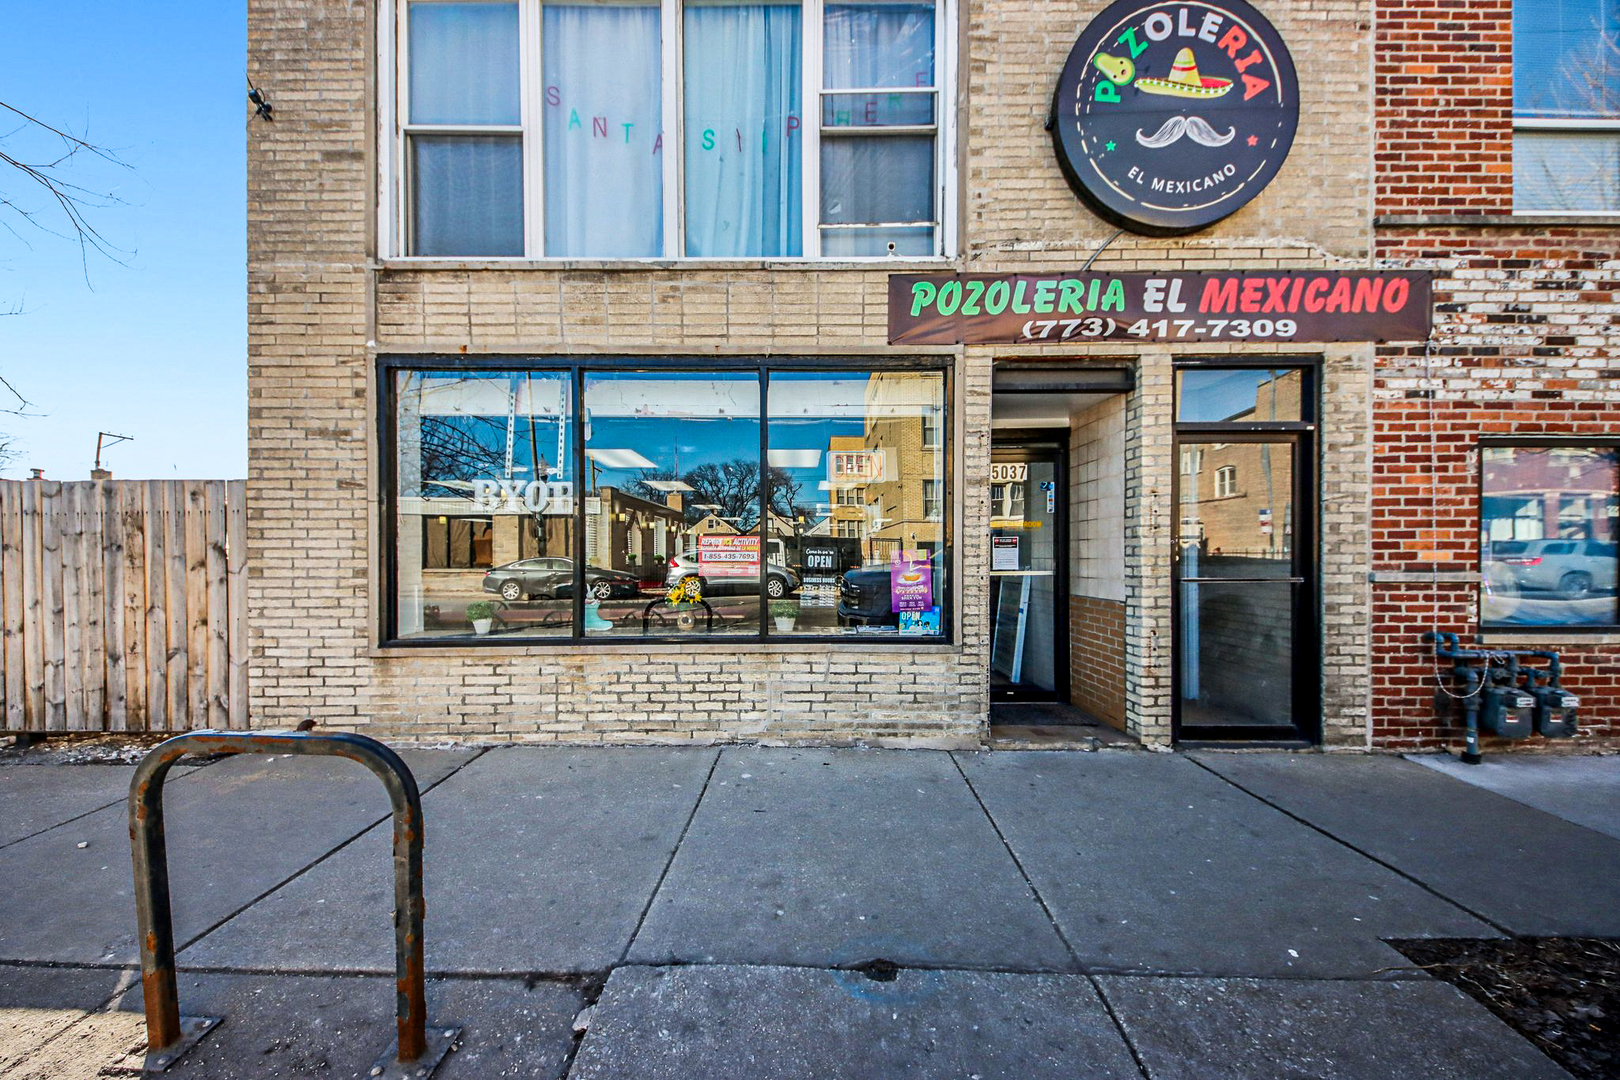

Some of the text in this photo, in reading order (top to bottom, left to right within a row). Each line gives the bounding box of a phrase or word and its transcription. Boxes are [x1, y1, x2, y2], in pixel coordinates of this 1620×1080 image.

[1094, 8, 1269, 103] POZOLERIA
[1127, 163, 1236, 194] EL MEXICANO
[910, 277, 1410, 317] POZOLERIA EL MEXICANO
[1022, 317, 1298, 339] (773) 417-7309
[832, 454, 882, 478] OPEN
[992, 465, 1026, 480] 5037
[807, 555, 832, 568] OPEN
[901, 611, 921, 620] OPEN
